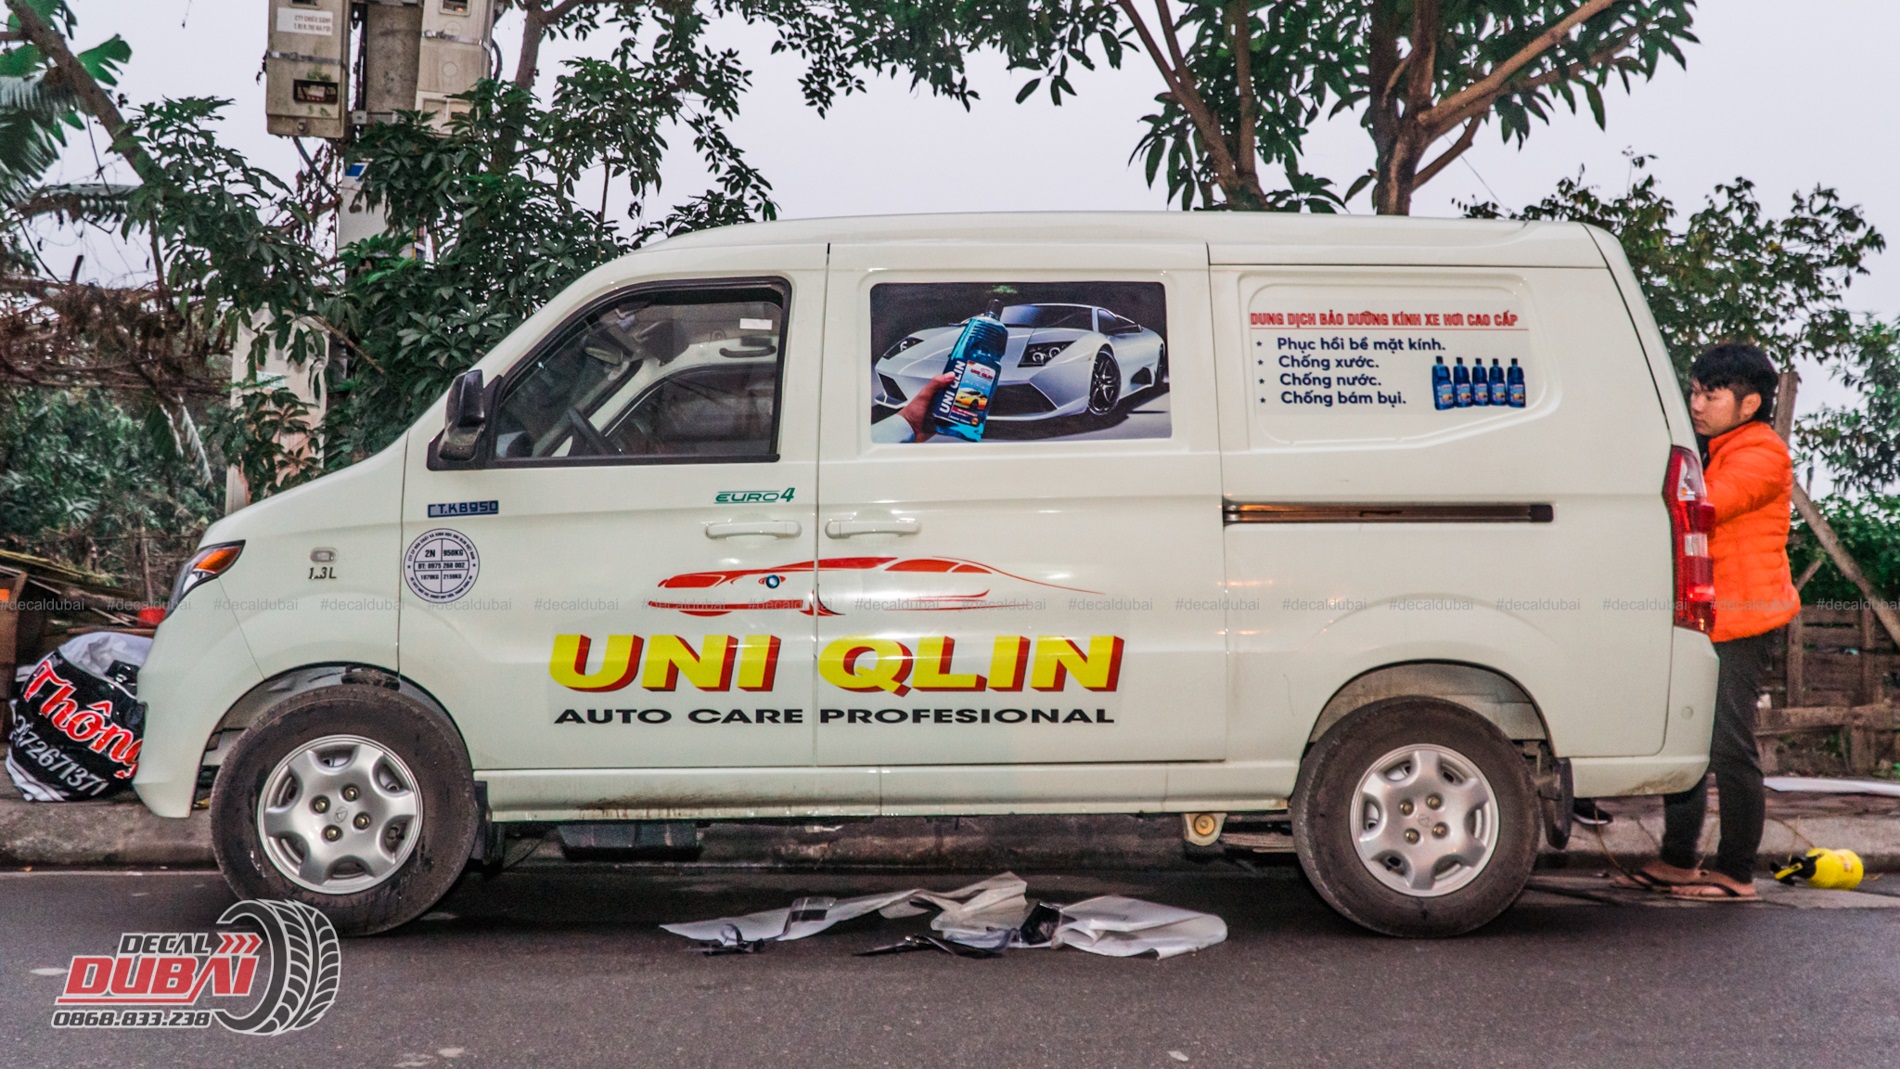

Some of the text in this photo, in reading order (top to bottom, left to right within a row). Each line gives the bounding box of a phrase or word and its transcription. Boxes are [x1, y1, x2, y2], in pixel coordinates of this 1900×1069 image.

[1250, 310, 1518, 328] DUNG DỊCH BẢO DƯỠNG KÍNH XE HƠI CAO CẤP
[1277, 336, 1446, 354] Phục hồi bề mặt kính.
[1278, 354, 1380, 371] Chống xước.
[1280, 372, 1382, 388] Chống nước.
[939, 390, 956, 414] UNI
[1280, 390, 1407, 408] Chống bám bụi.
[425, 549, 435, 558] 2N
[548, 634, 1124, 697] UNI QLIN
[554, 708, 1114, 724] AUTO CARE PROFESIONAL
